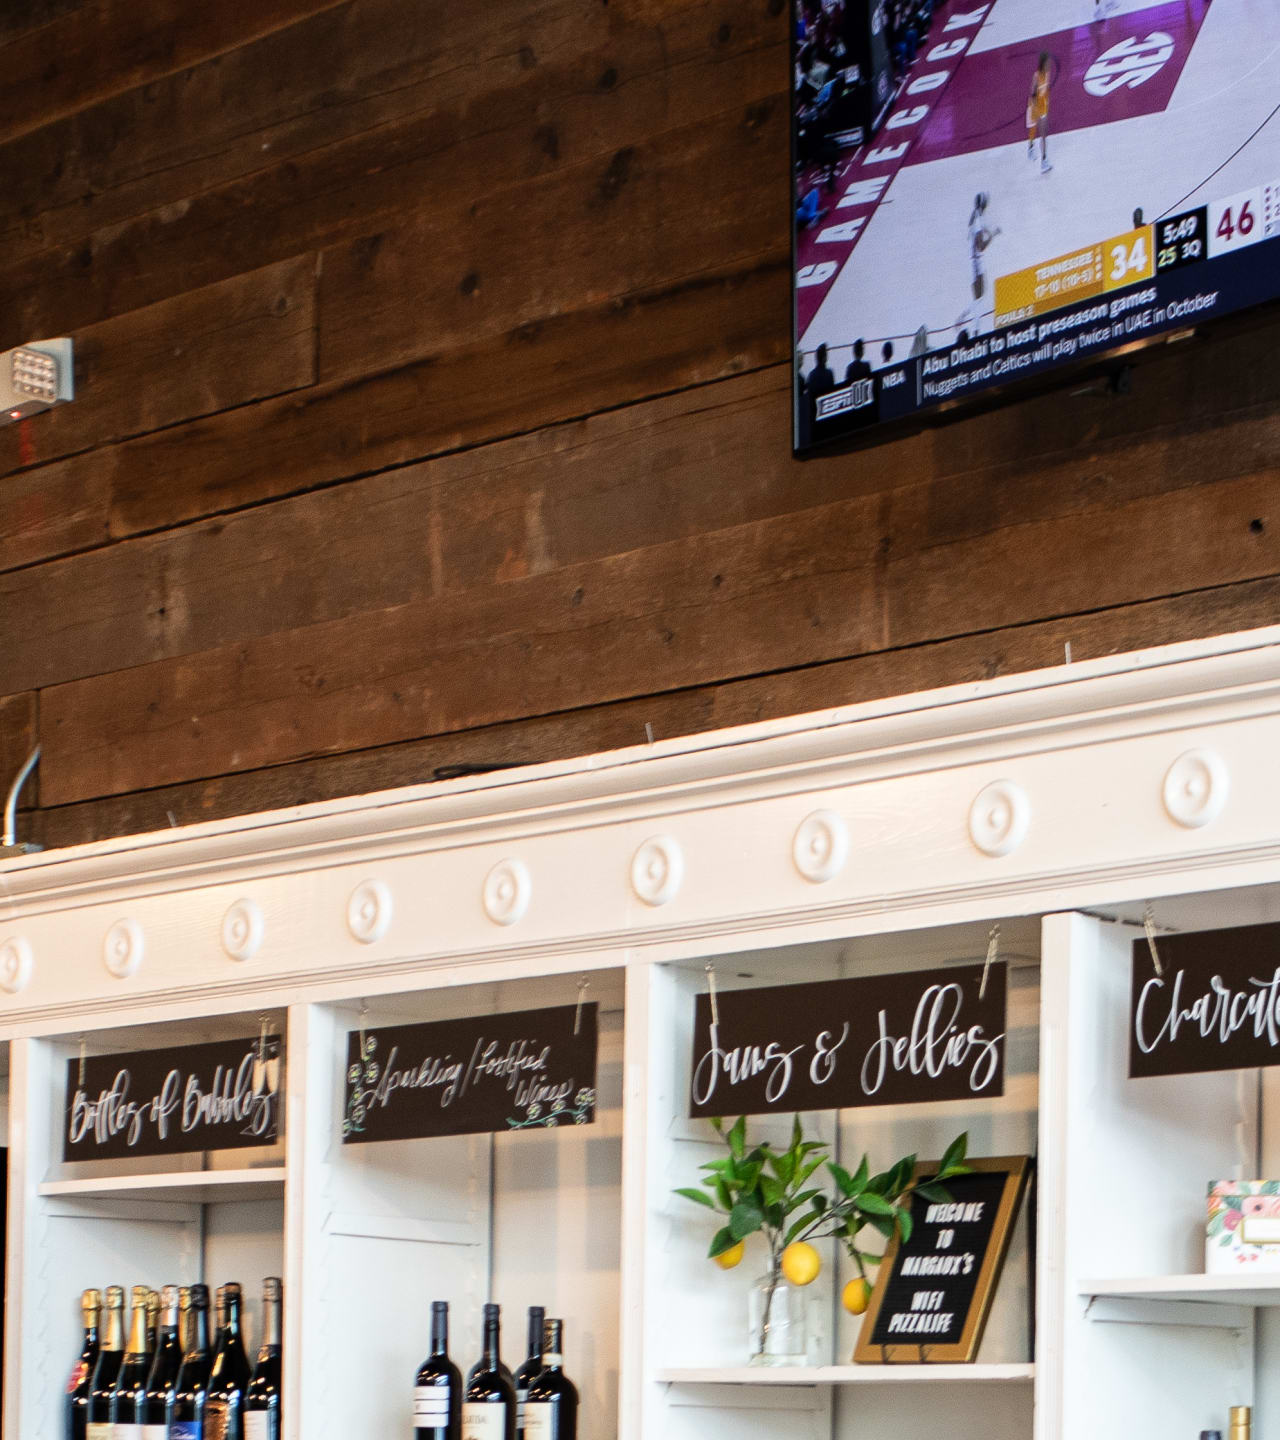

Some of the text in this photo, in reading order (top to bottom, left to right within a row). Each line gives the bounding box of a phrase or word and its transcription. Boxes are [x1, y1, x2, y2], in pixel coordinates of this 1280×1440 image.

[1083, 32, 1175, 96] SEC
[1162, 216, 1199, 246] 5:49
[1214, 199, 1255, 242] 46
[1110, 236, 1148, 281] 34
[1157, 238, 1202, 269] 25 3Q
[922, 286, 1158, 378] Abu Dhabi to host preseason games
[922, 289, 1221, 401] Nuggets and Celtics will play twice in UAE in October
[881, 369, 906, 392] NBA
[692, 982, 1007, 1107] Jams & Jellies
[149, 1068, 181, 1141] of
[924, 1200, 987, 1225] WELCOME
[934, 1228, 956, 1251] TO
[899, 1251, 976, 1277] MARGAUX'S
[909, 1289, 946, 1313] WIFI
[886, 1311, 956, 1335] PIZZALIFE
